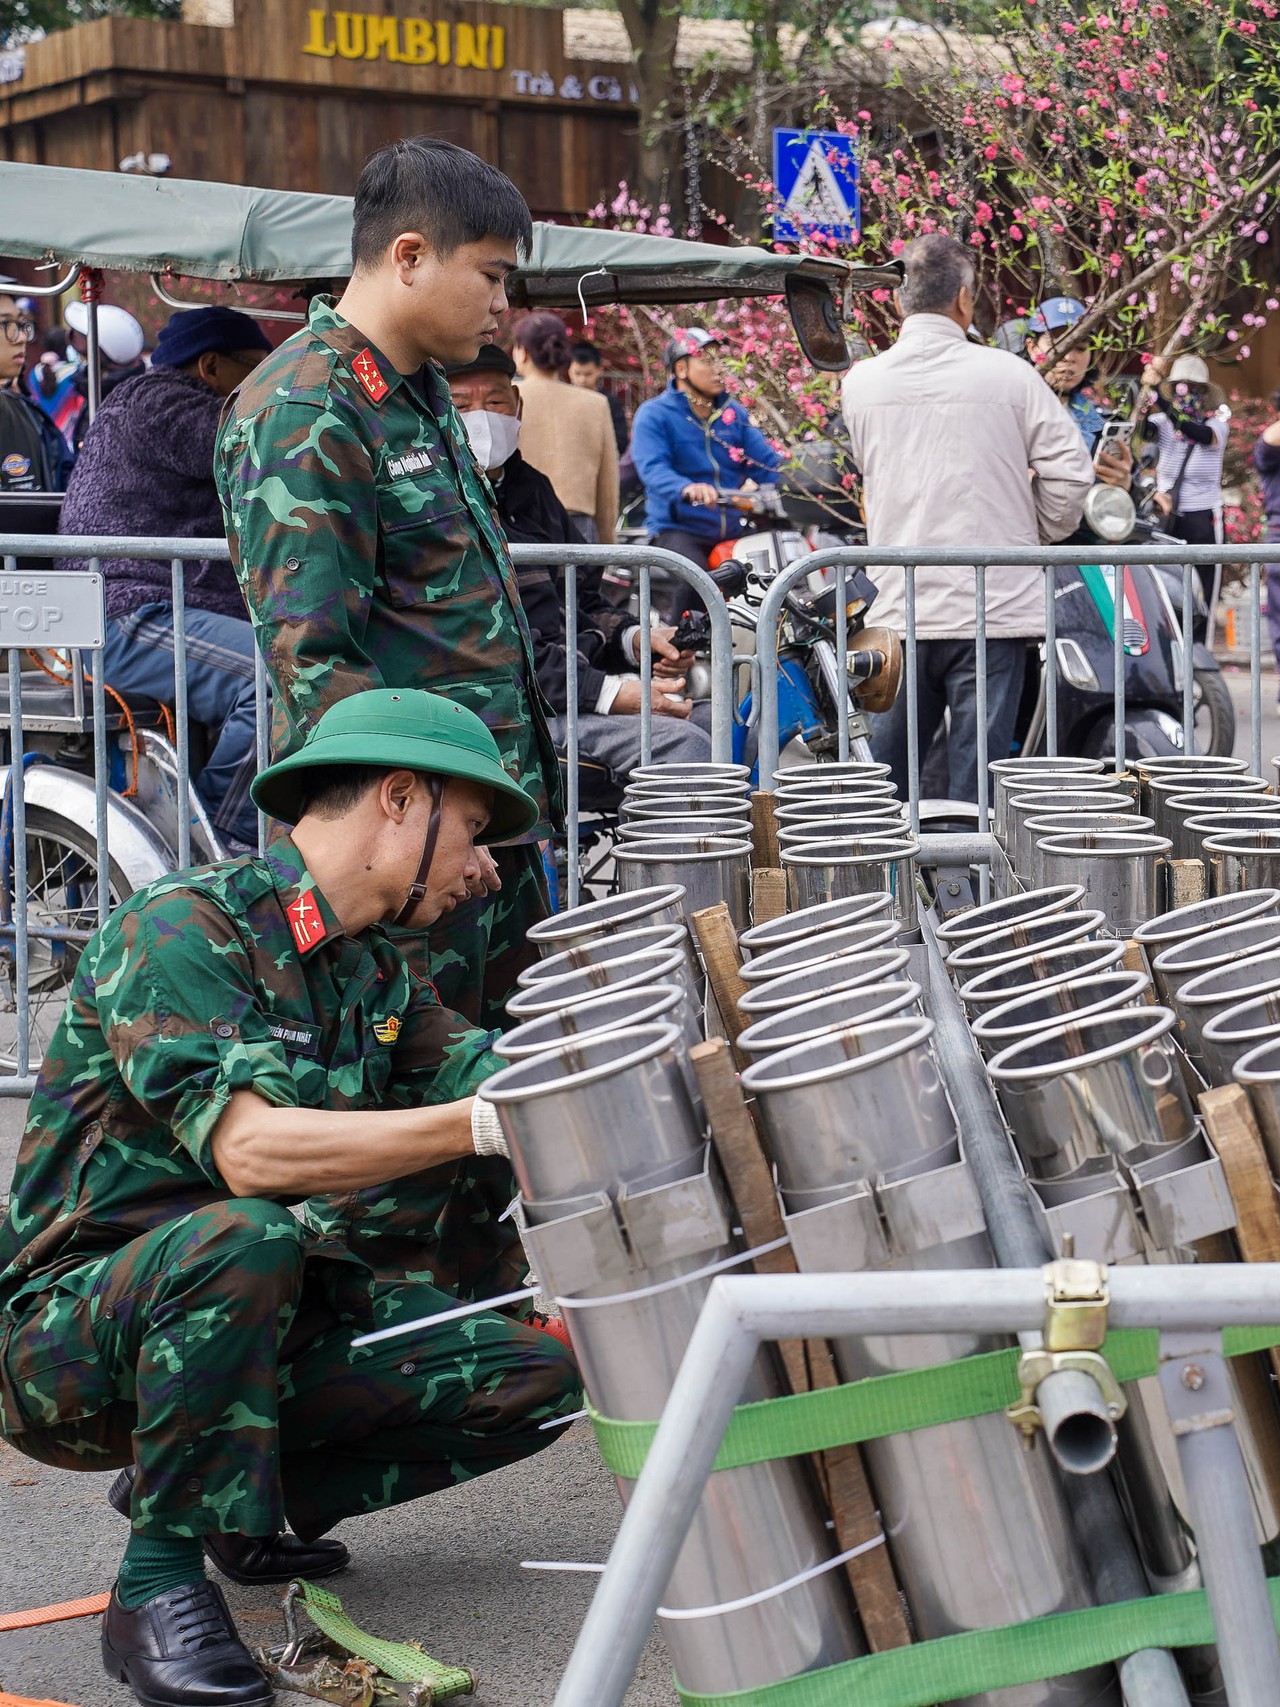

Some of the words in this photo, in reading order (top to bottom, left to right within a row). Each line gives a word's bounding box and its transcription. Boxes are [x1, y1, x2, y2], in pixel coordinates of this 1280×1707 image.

[303, 9, 505, 70] LUMBINI
[511, 69, 555, 97] Trà
[559, 74, 585, 100] &
[0, 580, 48, 596] LICE
[0, 606, 64, 632] OP
